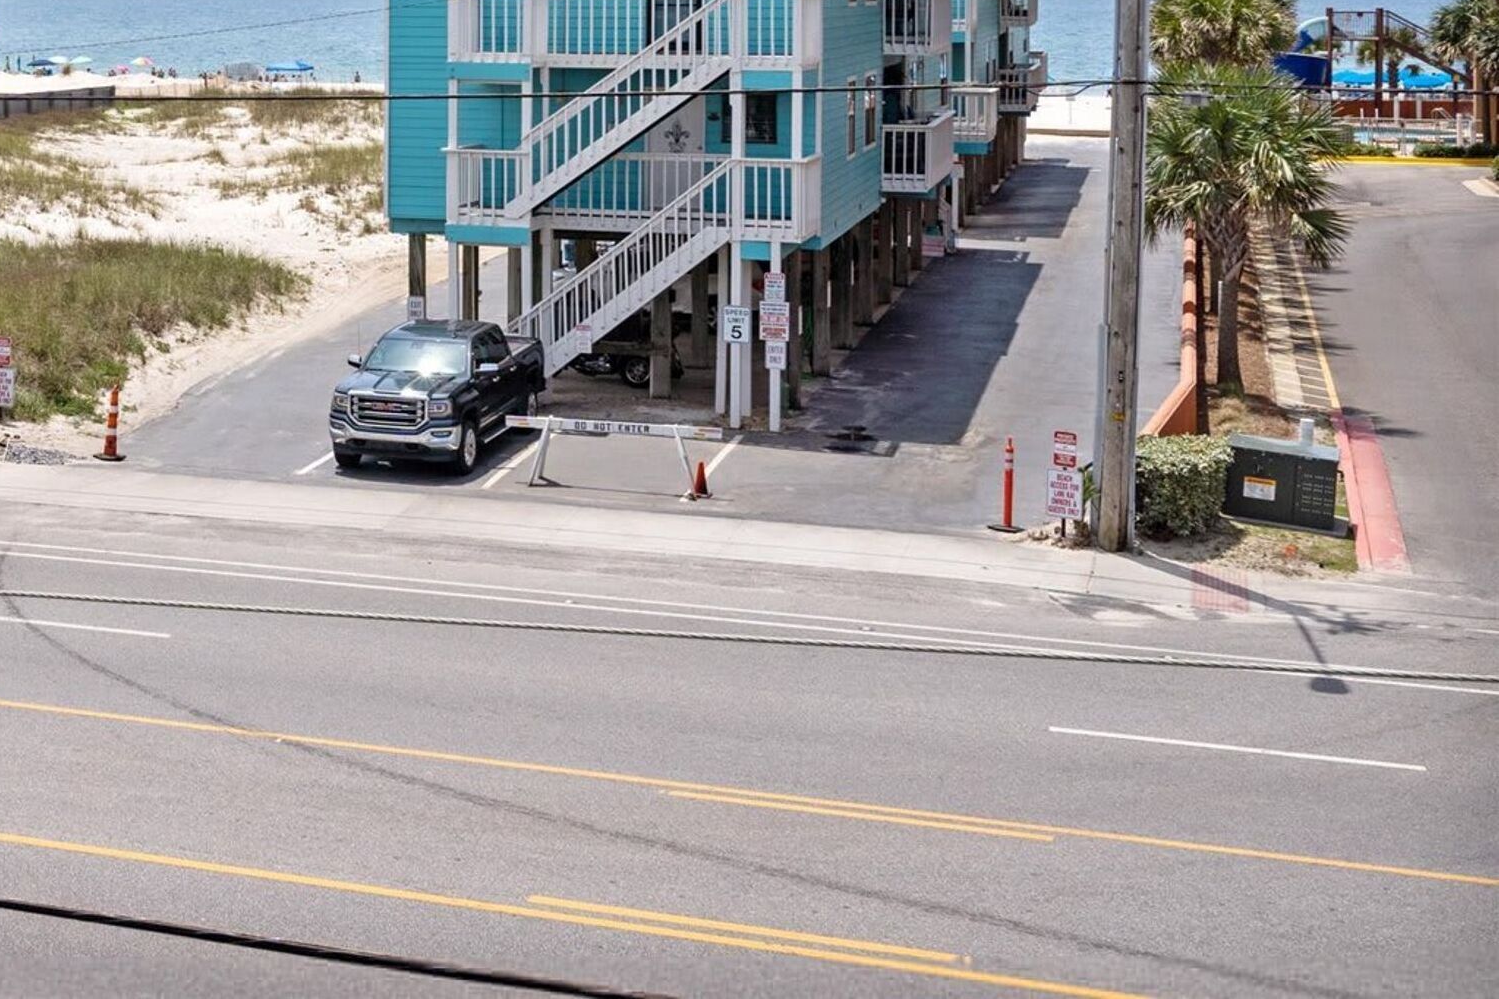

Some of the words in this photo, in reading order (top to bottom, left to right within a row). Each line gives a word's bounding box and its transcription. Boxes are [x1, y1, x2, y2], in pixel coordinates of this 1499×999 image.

[731, 325, 742, 339] 5
[372, 402, 401, 411] GMC
[575, 421, 587, 430] DO
[593, 422, 611, 431] NOT
[618, 424, 650, 433] ENTER
[1057, 473, 1072, 482] BEACH
